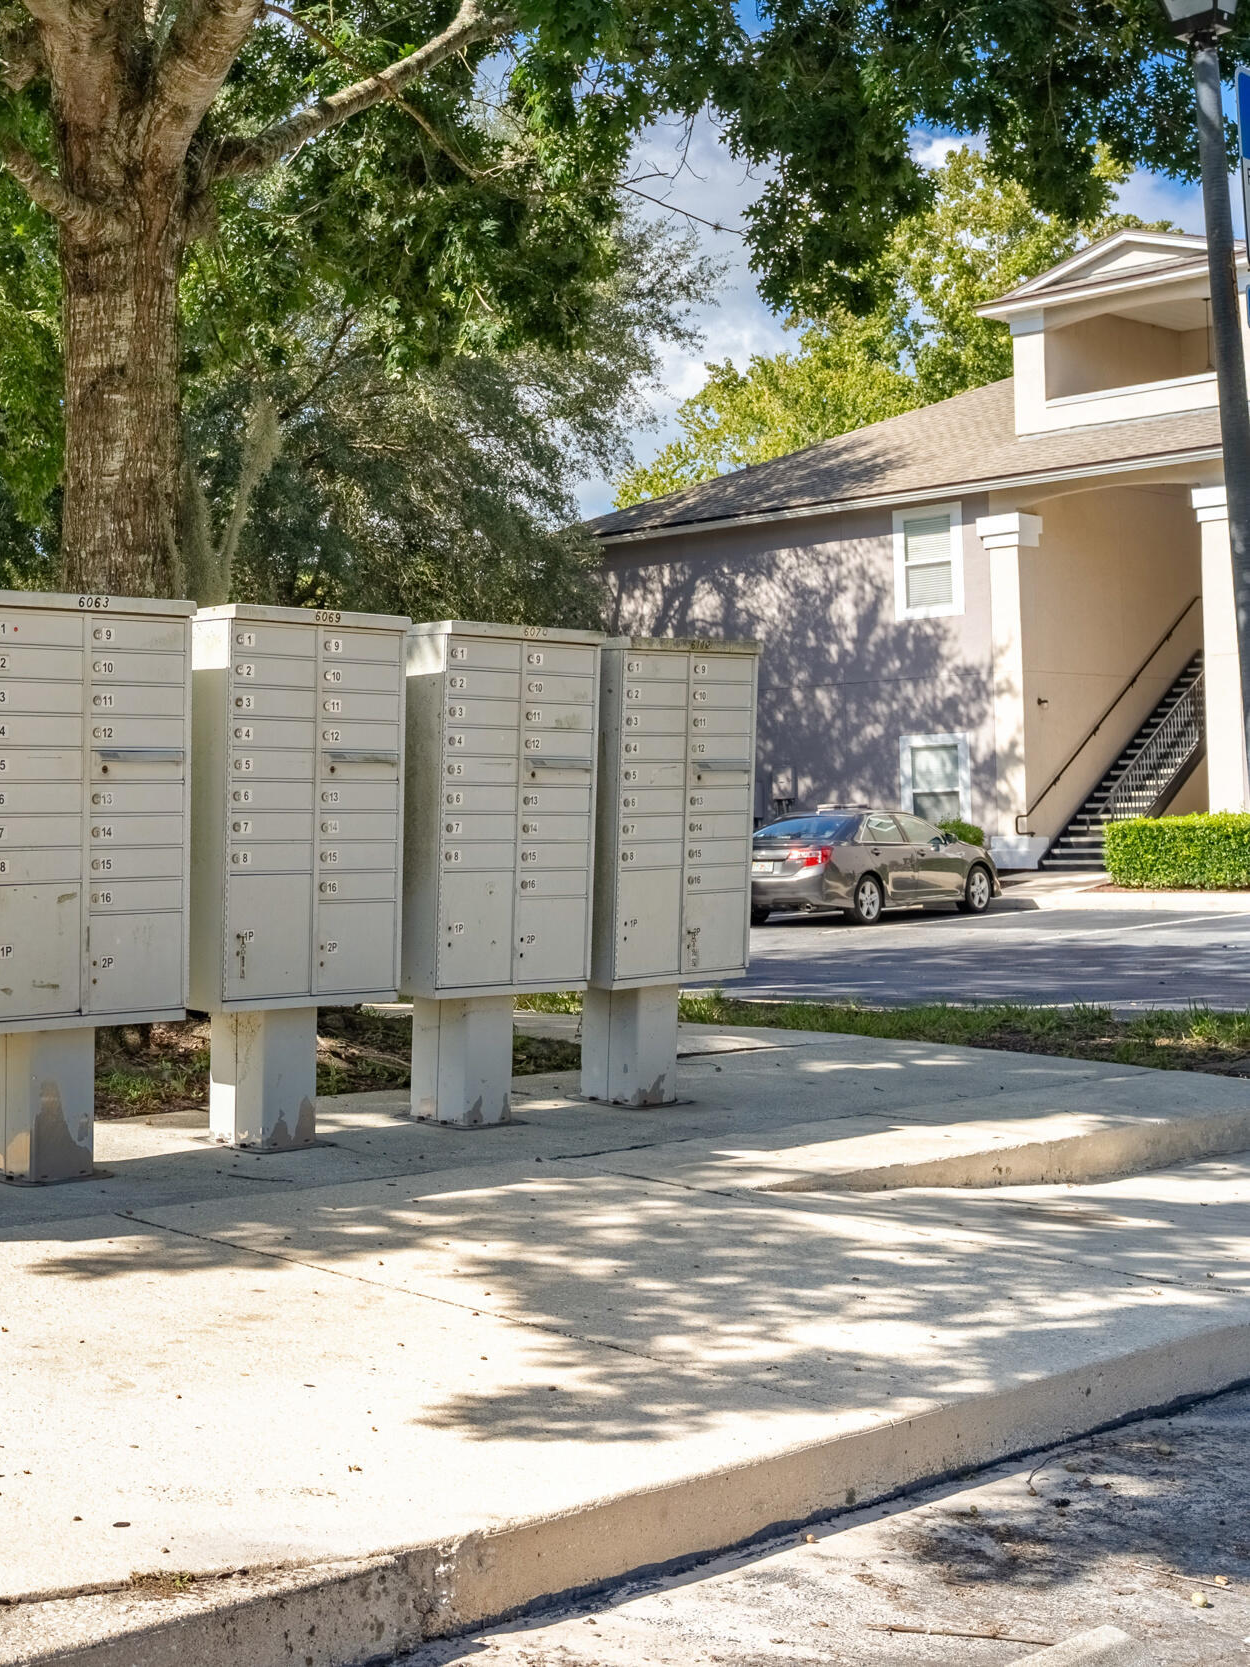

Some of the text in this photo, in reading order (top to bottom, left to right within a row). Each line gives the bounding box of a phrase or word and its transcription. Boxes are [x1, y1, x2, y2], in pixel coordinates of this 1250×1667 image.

[78, 596, 110, 609] 6063
[315, 611, 342, 624] 6069
[0, 624, 6, 633] 1
[106, 630, 111, 640] 9
[247, 635, 252, 644] 1
[334, 641, 340, 650] 9
[460, 649, 464, 658] 1
[1, 658, 6, 668] 2
[535, 655, 541, 664] 9
[103, 663, 113, 672] 10
[246, 666, 251, 675] 2
[635, 663, 640, 671] 1
[332, 672, 340, 681] 10
[459, 679, 464, 688] 2
[535, 684, 542, 692] 10
[0, 692, 5, 702] 3
[634, 690, 640, 698] 2
[103, 696, 112, 705] 11
[245, 698, 251, 707] 3
[332, 702, 339, 710] 11
[458, 707, 463, 716] 3
[533, 711, 541, 721] 11
[633, 717, 639, 725] 3
[700, 718, 706, 726] 11
[0, 726, 5, 736] 4
[103, 728, 112, 738] 12
[245, 729, 250, 738] 4
[331, 732, 339, 741] 12
[457, 736, 462, 745] 4
[532, 739, 539, 748] 12
[698, 744, 704, 752] 12
[0, 760, 5, 770] 5
[245, 760, 250, 769] 5
[456, 765, 462, 774] 5
[632, 771, 637, 779] 5
[0, 794, 4, 804] 6
[102, 794, 112, 804] 13
[244, 791, 249, 800] 6
[330, 792, 338, 801] 13
[455, 794, 461, 803] 6
[530, 796, 538, 805] 13
[696, 797, 704, 805] 13
[243, 822, 249, 831] 7
[454, 823, 460, 832] 7
[530, 824, 537, 833] 14
[630, 825, 635, 833] 7
[0, 828, 4, 838] 7
[102, 827, 111, 837] 14
[242, 853, 248, 863] 8
[329, 852, 337, 861] 15
[453, 852, 459, 861] 8
[529, 852, 536, 860] 15
[694, 850, 702, 858] 15
[0, 862, 5, 872] 8
[101, 860, 111, 869] 15
[328, 883, 336, 892] 16
[527, 880, 536, 889] 16
[101, 893, 111, 902] 16
[455, 924, 463, 932] 1P
[245, 931, 254, 941] 1P
[527, 935, 535, 944] 2P
[1, 946, 12, 957] 1P
[328, 943, 337, 952] 2P
[102, 958, 113, 968] 2P
